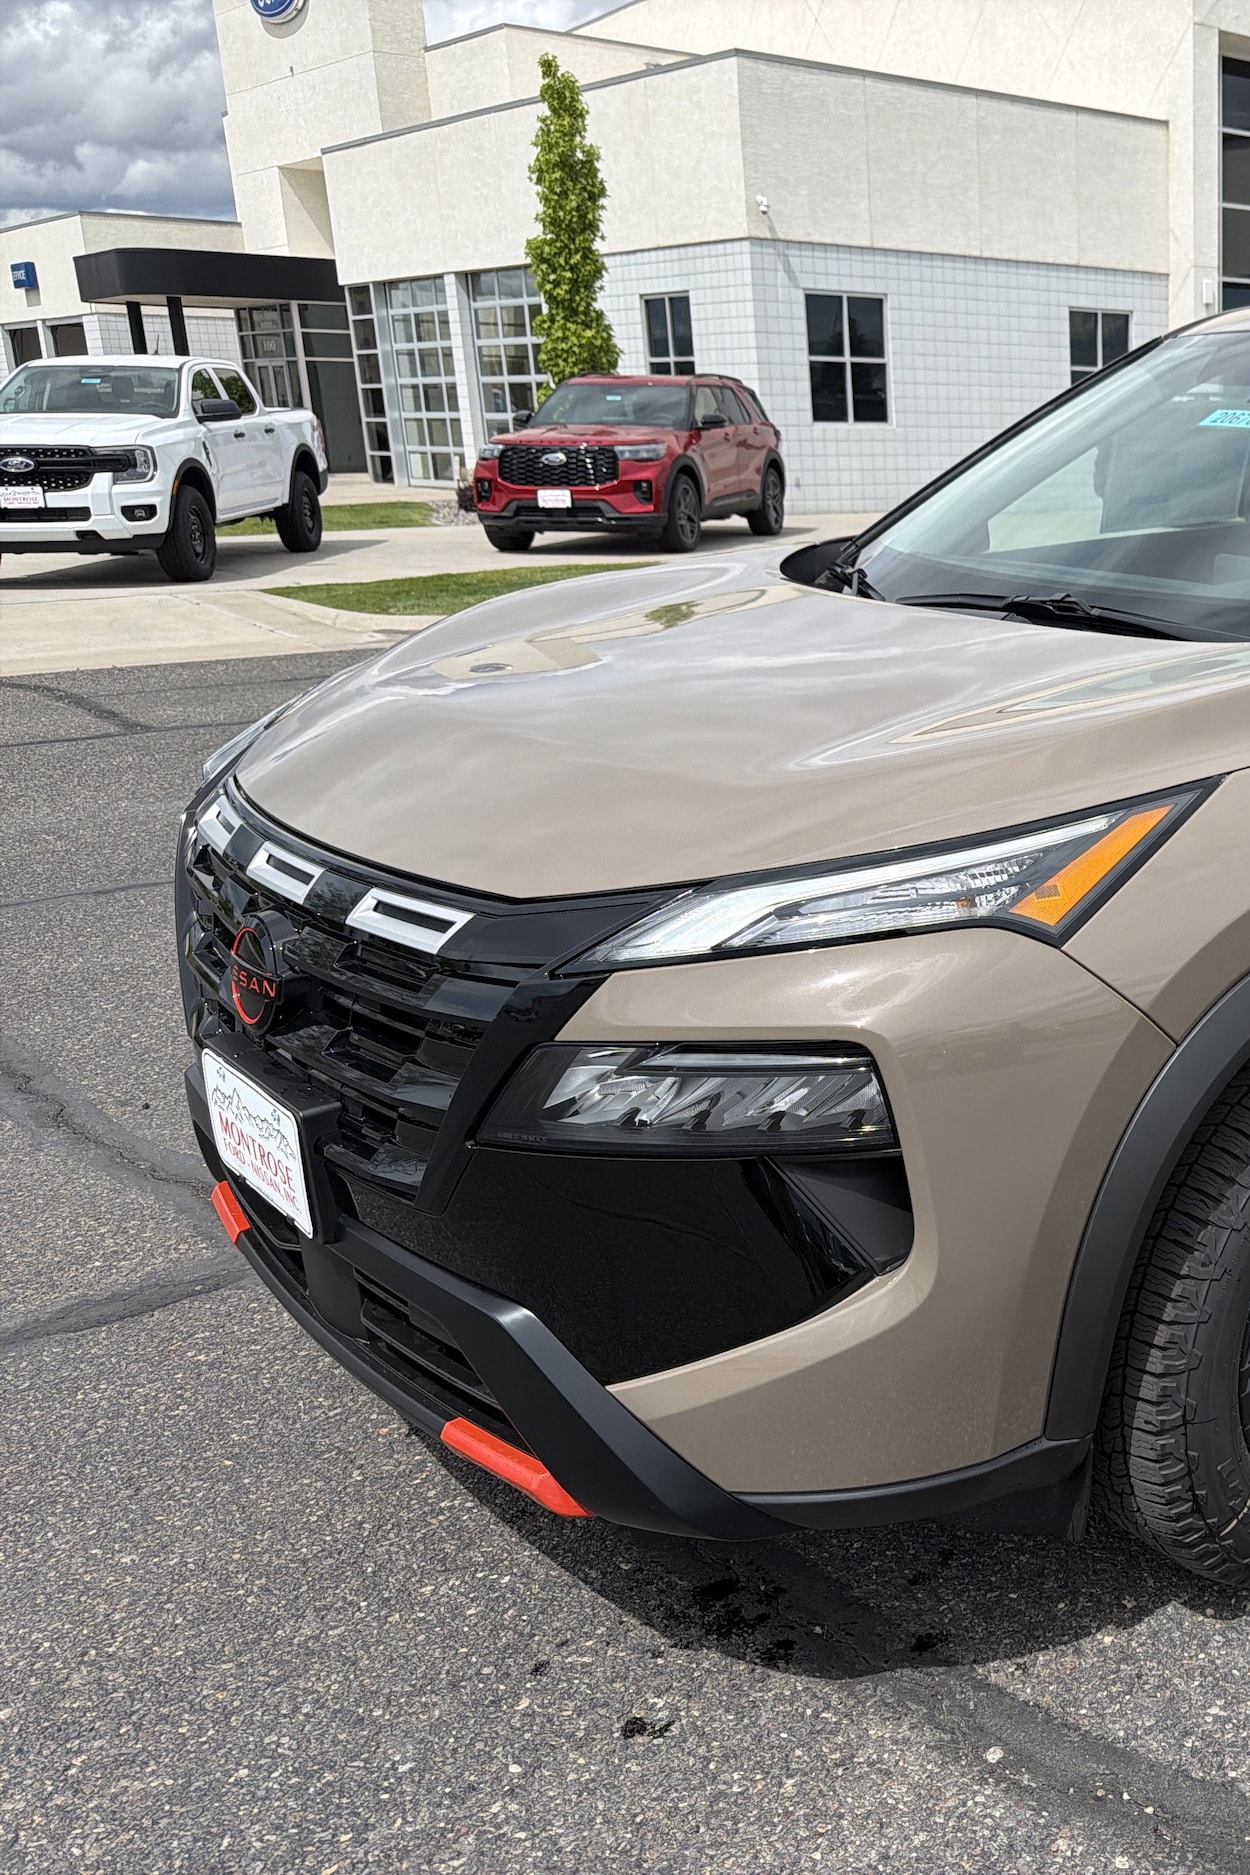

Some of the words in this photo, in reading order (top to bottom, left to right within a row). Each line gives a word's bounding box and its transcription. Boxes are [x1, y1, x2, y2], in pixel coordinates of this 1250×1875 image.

[263, 340, 276, 351] 100
[218, 1111, 296, 1194] MONTROSE
[223, 1137, 246, 1166] FORD
